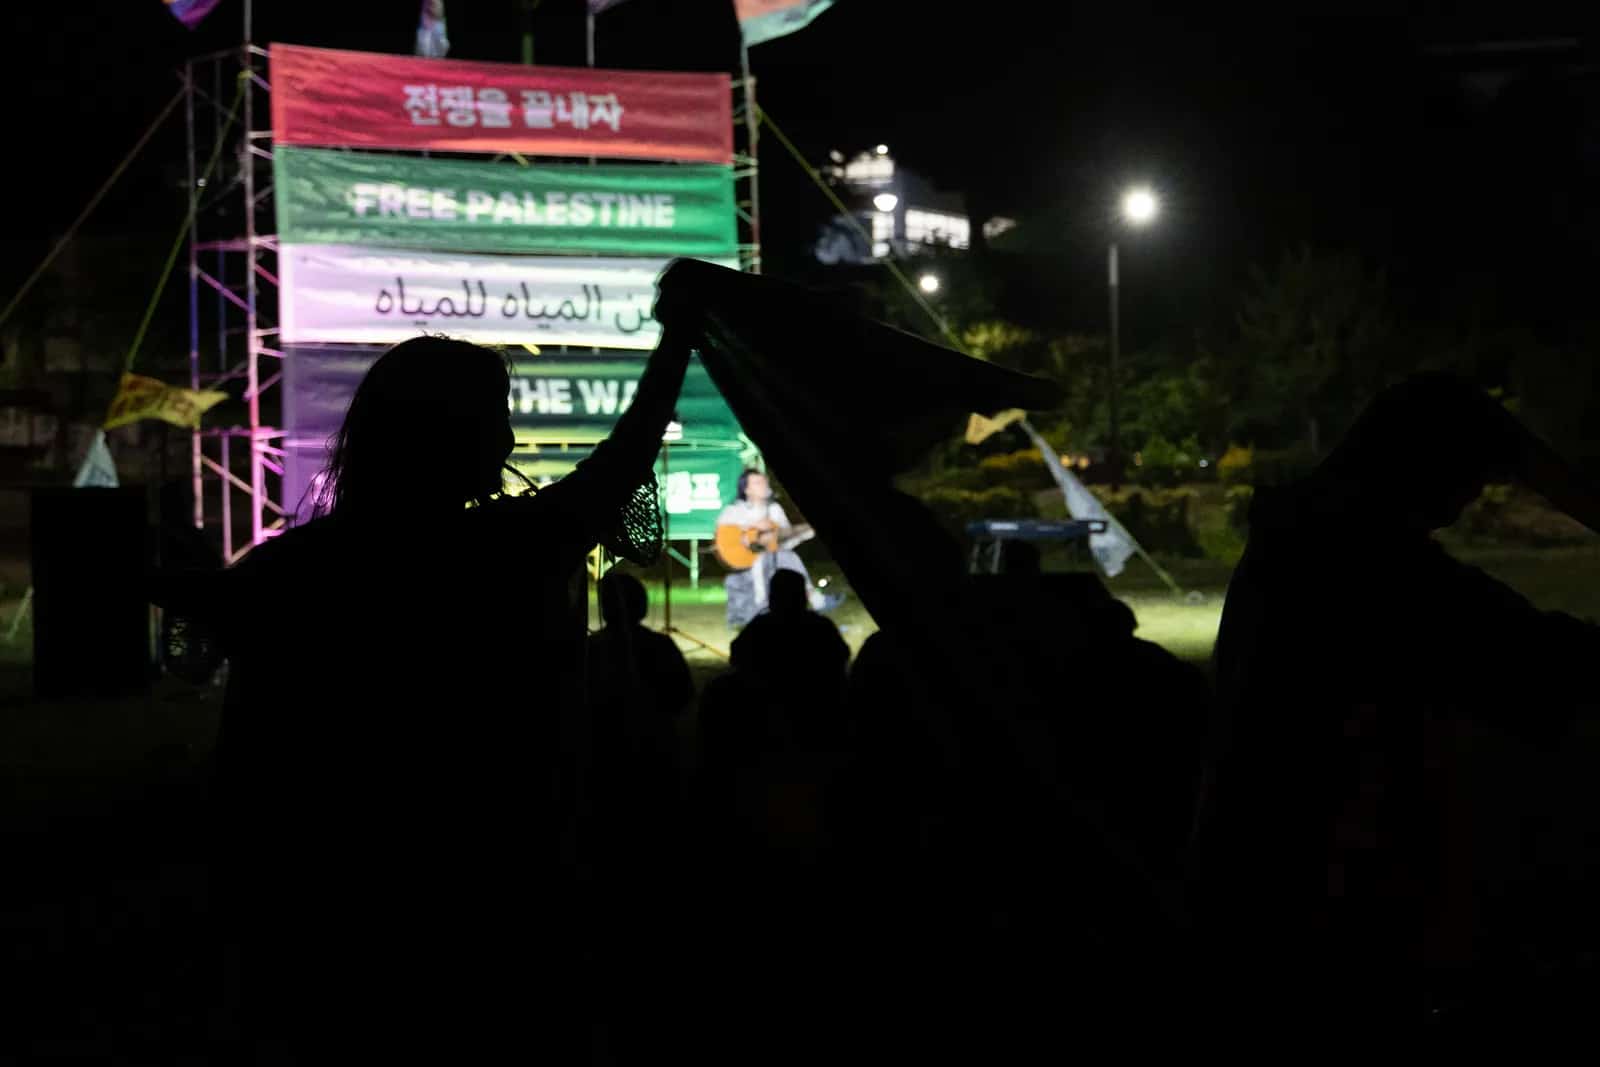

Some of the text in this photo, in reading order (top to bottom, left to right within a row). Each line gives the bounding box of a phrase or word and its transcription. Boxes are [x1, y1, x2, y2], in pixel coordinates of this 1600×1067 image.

[403, 84, 624, 132] 전쟁을 끝내자
[351, 183, 676, 228] FREE PALESTINE
[375, 276, 487, 326] للمياه
[501, 281, 602, 329] المياه
